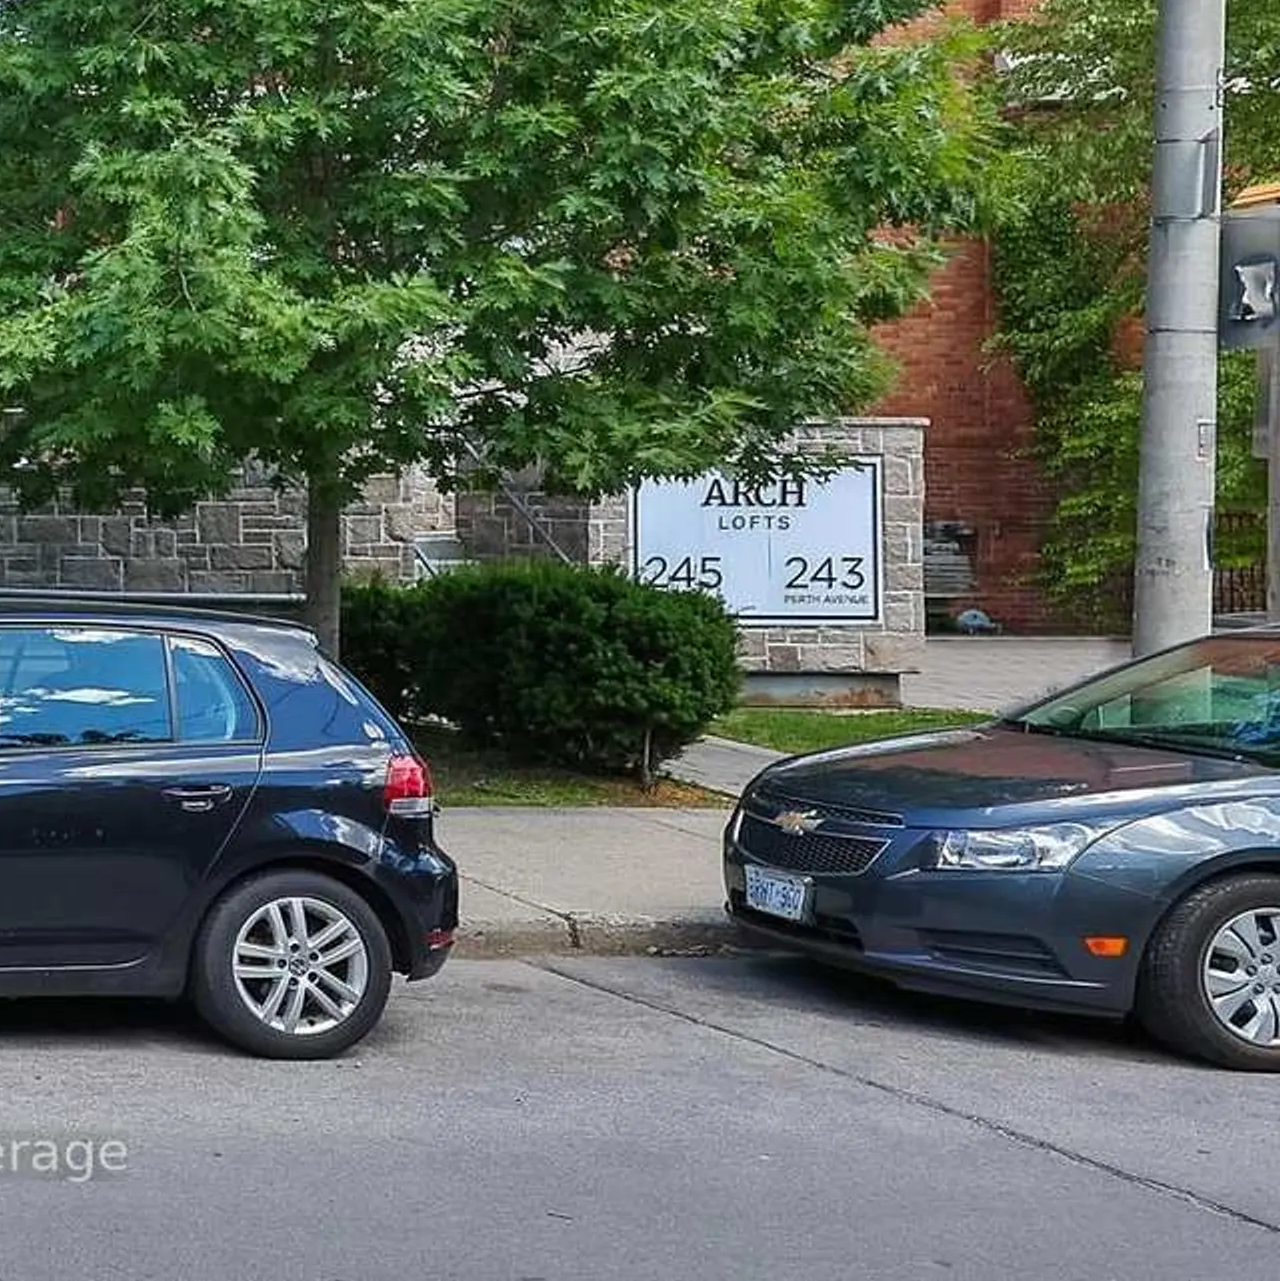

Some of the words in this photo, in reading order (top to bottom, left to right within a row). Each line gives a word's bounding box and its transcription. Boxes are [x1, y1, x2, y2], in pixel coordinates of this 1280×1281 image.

[700, 477, 808, 507] ARCH
[718, 515, 791, 531] LOFTS
[644, 556, 723, 589] 245
[784, 556, 866, 589] 243
